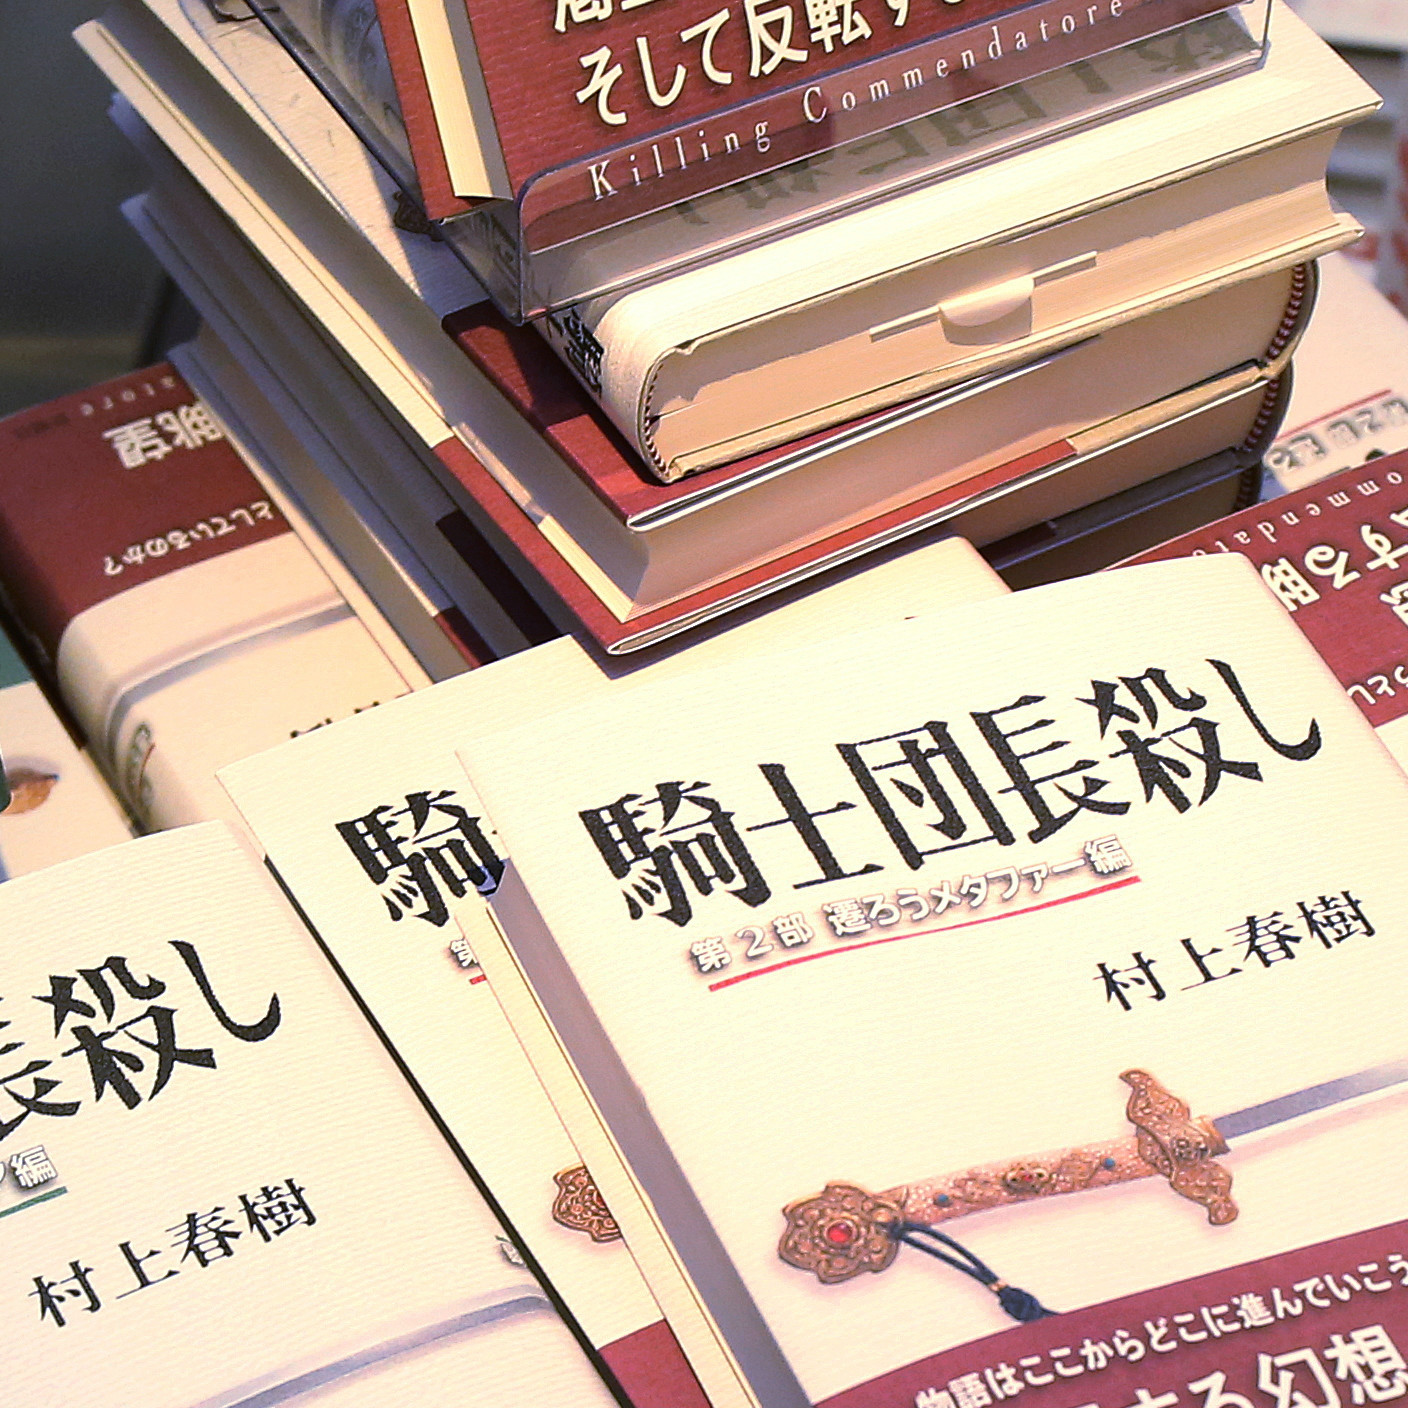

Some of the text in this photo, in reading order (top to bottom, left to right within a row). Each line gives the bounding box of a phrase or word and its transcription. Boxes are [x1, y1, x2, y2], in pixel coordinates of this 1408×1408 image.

[587, 115, 772, 200] Killing
[802, 0, 1124, 123] Commendatore
[102, 500, 275, 577] としているのか？
[579, 658, 1325, 930] 騎士団長殺し
[690, 911, 814, 974] 第2部
[1093, 887, 1378, 1014] 村上春樹
[29, 1176, 320, 1330] 村上春樹
